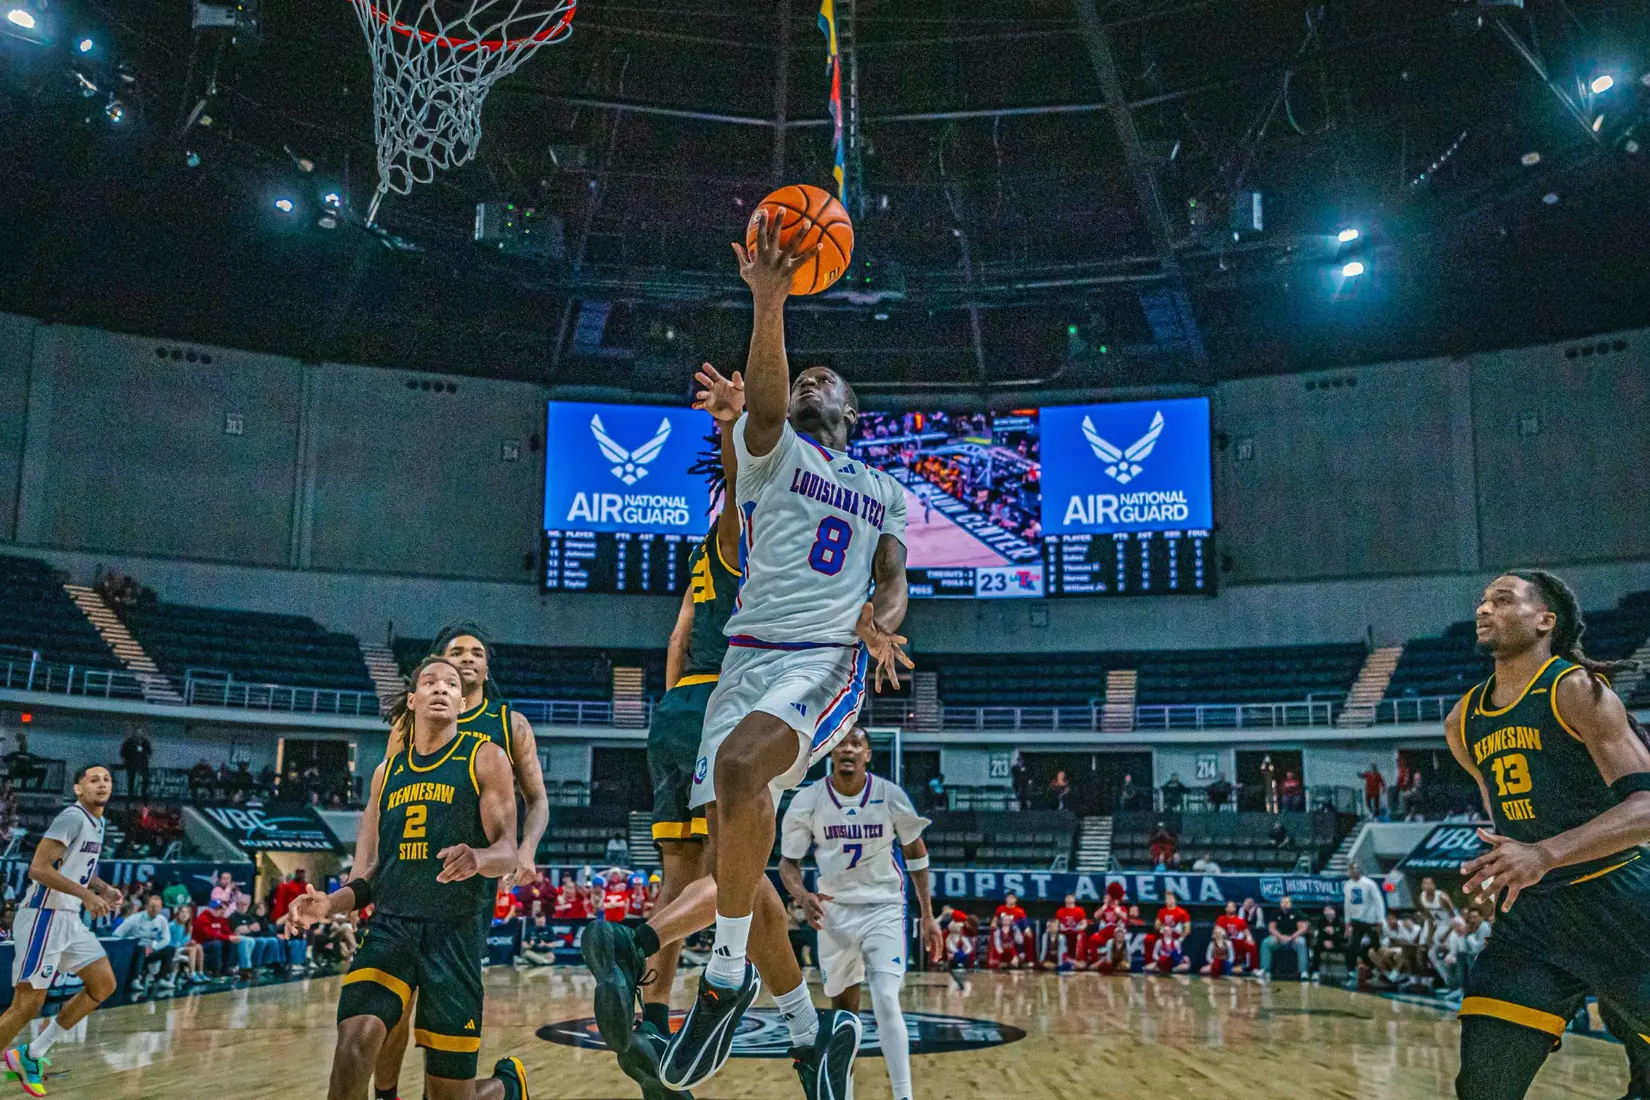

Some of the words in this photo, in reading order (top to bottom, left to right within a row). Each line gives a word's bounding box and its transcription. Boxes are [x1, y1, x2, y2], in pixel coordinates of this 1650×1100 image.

[624, 494, 689, 510] NATIONAL
[790, 468, 859, 516] LOUISIANA
[1120, 491, 1188, 506] NATIONAL
[567, 492, 623, 523] AIR
[623, 508, 690, 526] GUARD
[1063, 494, 1119, 525] AIR
[1120, 504, 1189, 523] GUARD
[565, 531, 594, 539] PLAYER
[808, 515, 854, 577] 8
[1063, 534, 1092, 542] PLAYER
[980, 573, 1006, 592] 23
[1474, 726, 1542, 766] KENNESAW
[1492, 753, 1532, 796] 13
[387, 782, 456, 812] KENNESAW
[204, 808, 278, 830] VBC
[1502, 798, 1536, 820] STATE
[403, 804, 428, 838] 2
[824, 824, 862, 840] LOUISIANA
[863, 824, 884, 838] TECH
[238, 838, 334, 849] HUNTSVILLE
[400, 842, 428, 860] STATE
[842, 844, 862, 870] 7
[80, 858, 96, 885] 3
